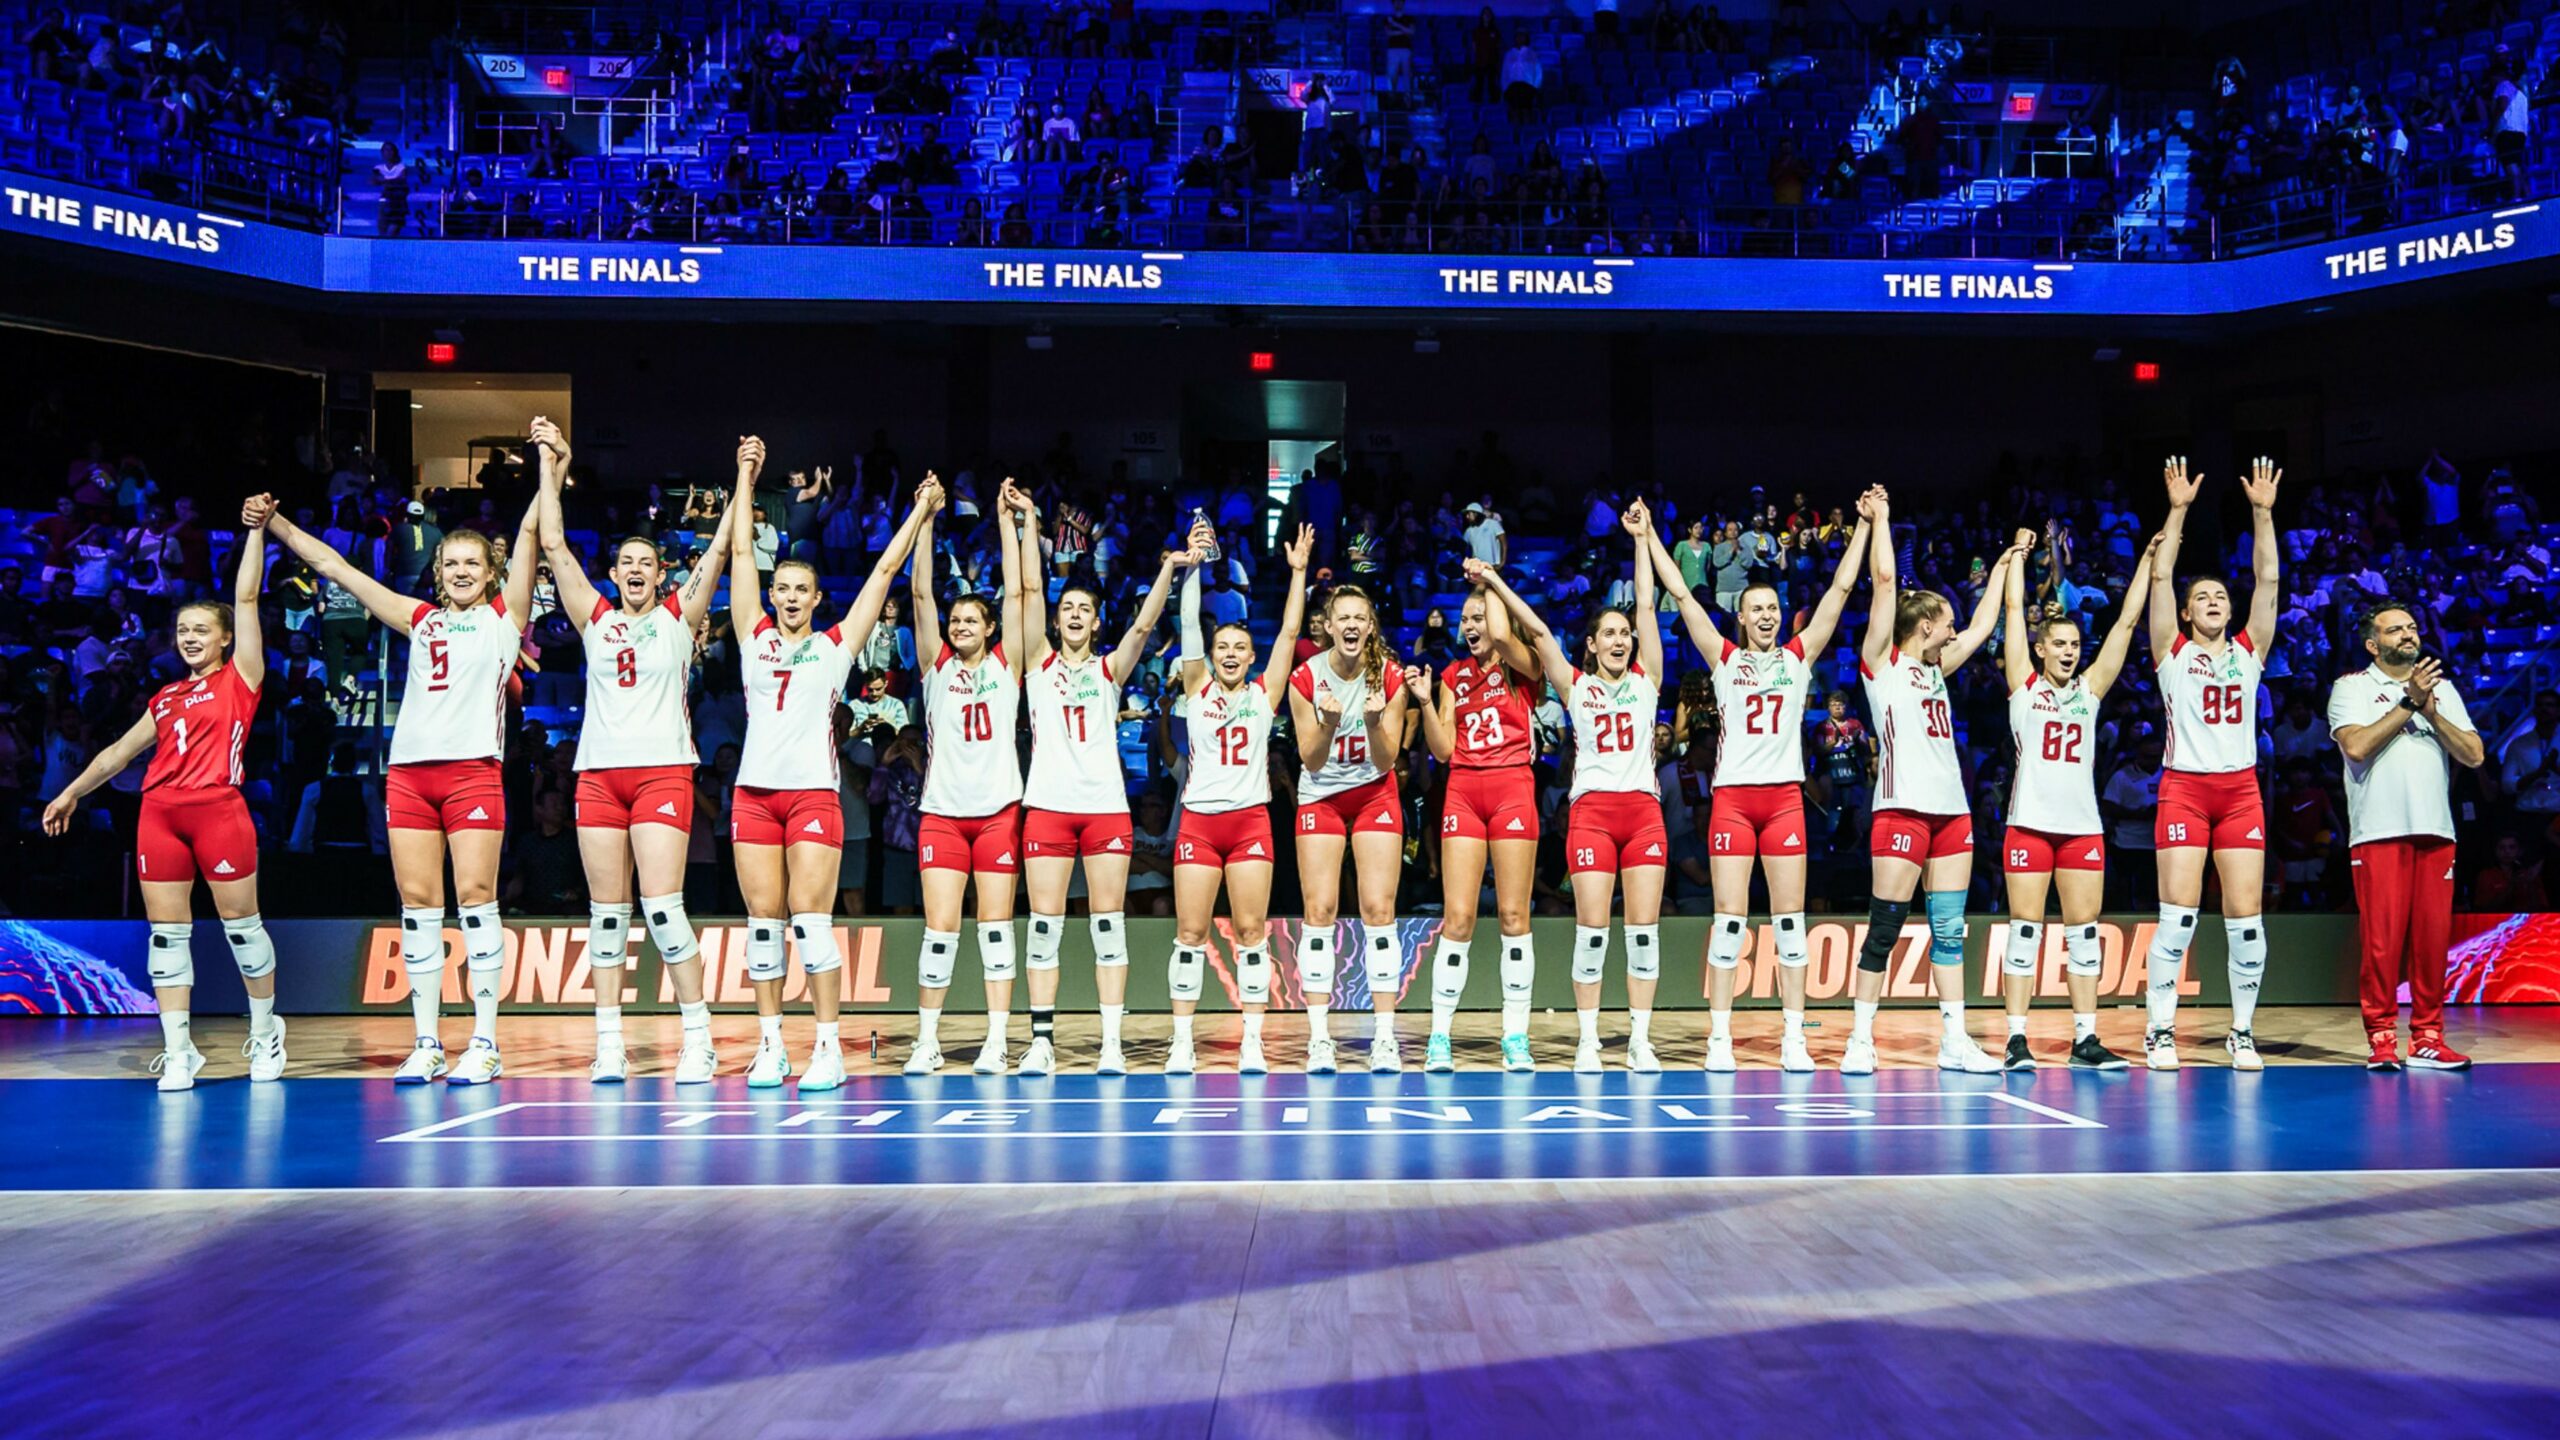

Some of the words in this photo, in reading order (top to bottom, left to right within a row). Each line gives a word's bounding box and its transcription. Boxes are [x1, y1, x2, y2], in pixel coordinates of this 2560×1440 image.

[490, 60, 517, 73] 205
[597, 62, 623, 74] 206
[5, 187, 81, 227] THE
[93, 205, 219, 253] FINALS
[2325, 246, 2387, 280] THE
[2398, 223, 2515, 267] FINALS
[518, 256, 580, 281] THE
[590, 257, 700, 283] FINALS
[984, 263, 1044, 287] THE
[1055, 264, 1162, 289] FINALS
[1439, 269, 1498, 293] THE
[1508, 270, 1613, 294] FINALS
[1883, 274, 1941, 298] THE
[1951, 275, 2053, 299] FINALS
[429, 640, 449, 681] 5
[616, 646, 637, 688] 9
[792, 653, 820, 665] plus
[1733, 678, 1759, 687] ORLEN
[2187, 666, 2216, 679] ORLEN
[2227, 667, 2244, 680] pl
[184, 690, 215, 709] plus
[773, 670, 793, 712] 7
[948, 684, 973, 694] ORLEN
[1483, 687, 1506, 702] plus
[1202, 710, 1228, 721] ORLEN
[1746, 694, 1784, 735] 27
[2202, 684, 2243, 725] 95
[962, 701, 993, 742] 10
[1062, 705, 1086, 742] 11
[1464, 706, 1505, 751] 23
[1921, 698, 1951, 740] 30
[172, 717, 188, 756] 1
[1594, 712, 1634, 753] 26
[2042, 720, 2082, 764] 62
[1215, 725, 1249, 766] 12
[1334, 735, 1366, 764] 15
[1300, 812, 1316, 831] 15
[1442, 814, 1459, 833] 23
[2167, 822, 2187, 842] 95
[922, 844, 934, 864] 10
[1179, 842, 1195, 861] 12
[1713, 832, 1732, 851] 27
[1891, 832, 1912, 853] 30
[140, 854, 147, 874] 1
[1576, 847, 1595, 867] 26
[2010, 848, 2029, 867] 62
[660, 1109, 1031, 1127] THE
[1152, 1102, 1876, 1124] FINALS
